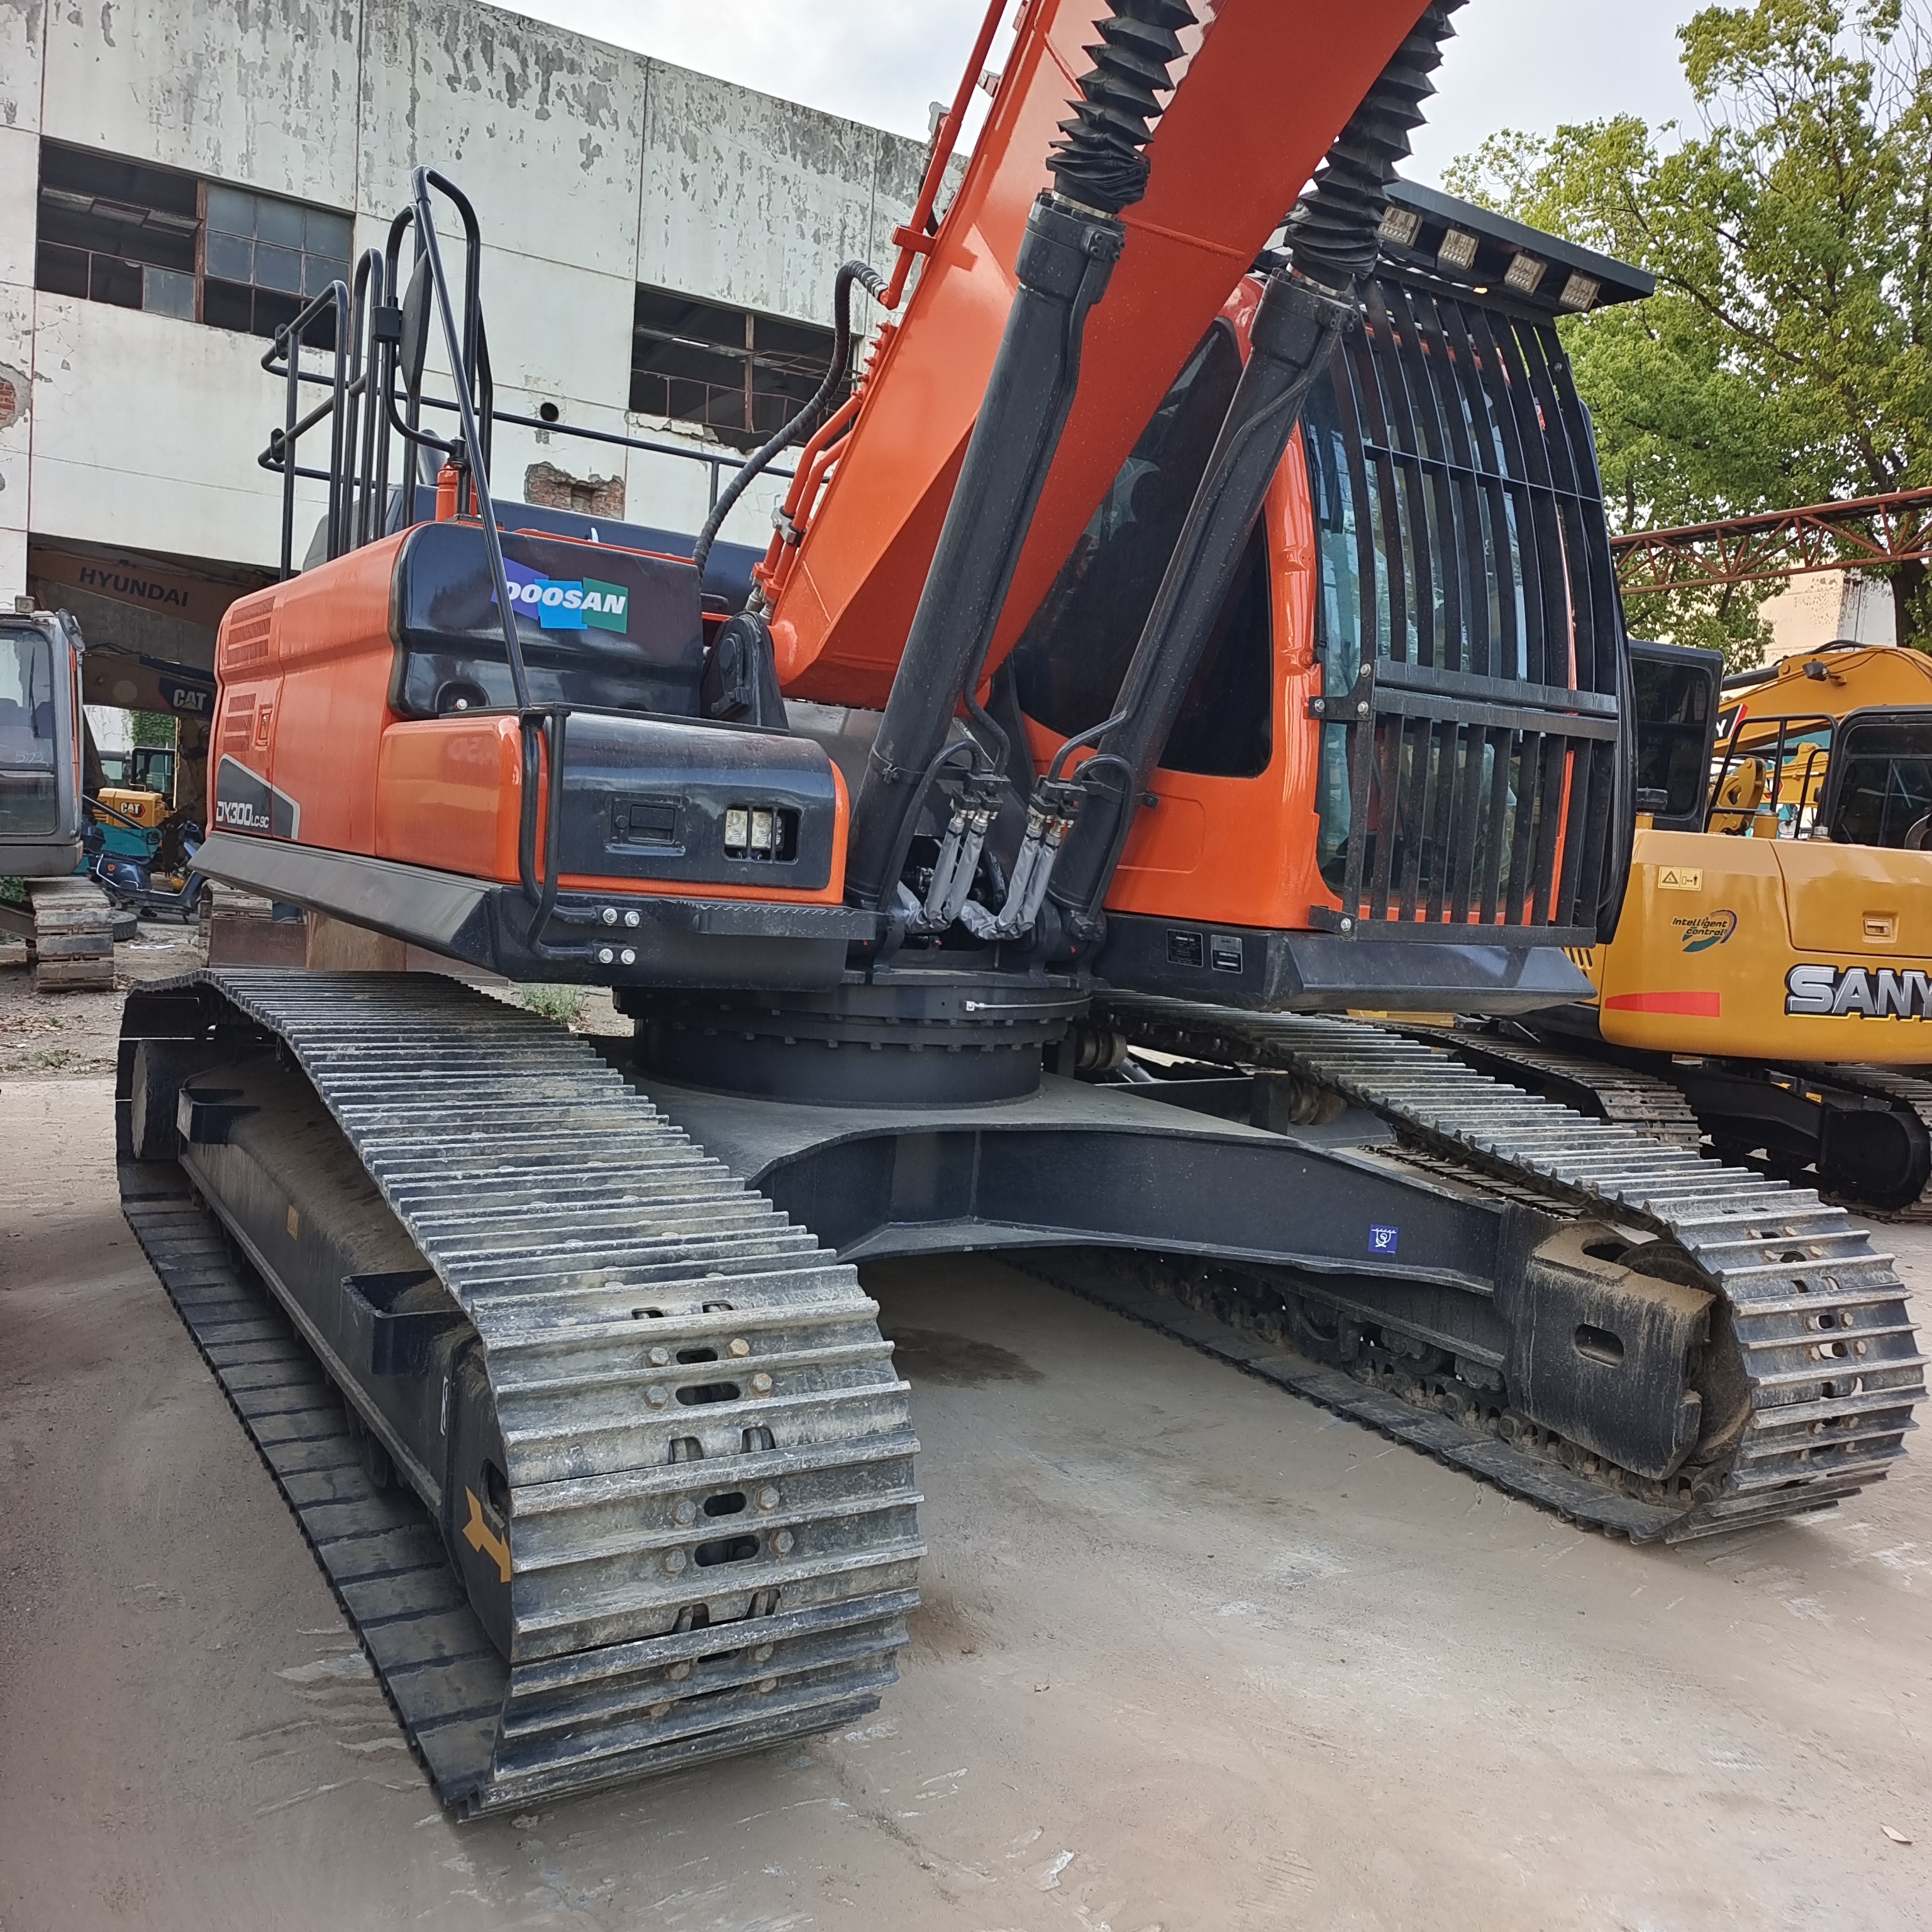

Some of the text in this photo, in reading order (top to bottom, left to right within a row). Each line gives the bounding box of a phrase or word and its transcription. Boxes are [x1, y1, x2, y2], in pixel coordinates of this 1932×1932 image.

[79, 567, 189, 608] HYUNDAI
[506, 580, 626, 614] DOOSAN
[173, 689, 207, 711] CAT
[120, 802, 140, 814] CAT
[1672, 917, 1728, 929] Intelligent
[1686, 928, 1724, 936] control
[1787, 965, 1932, 1018] SANY
